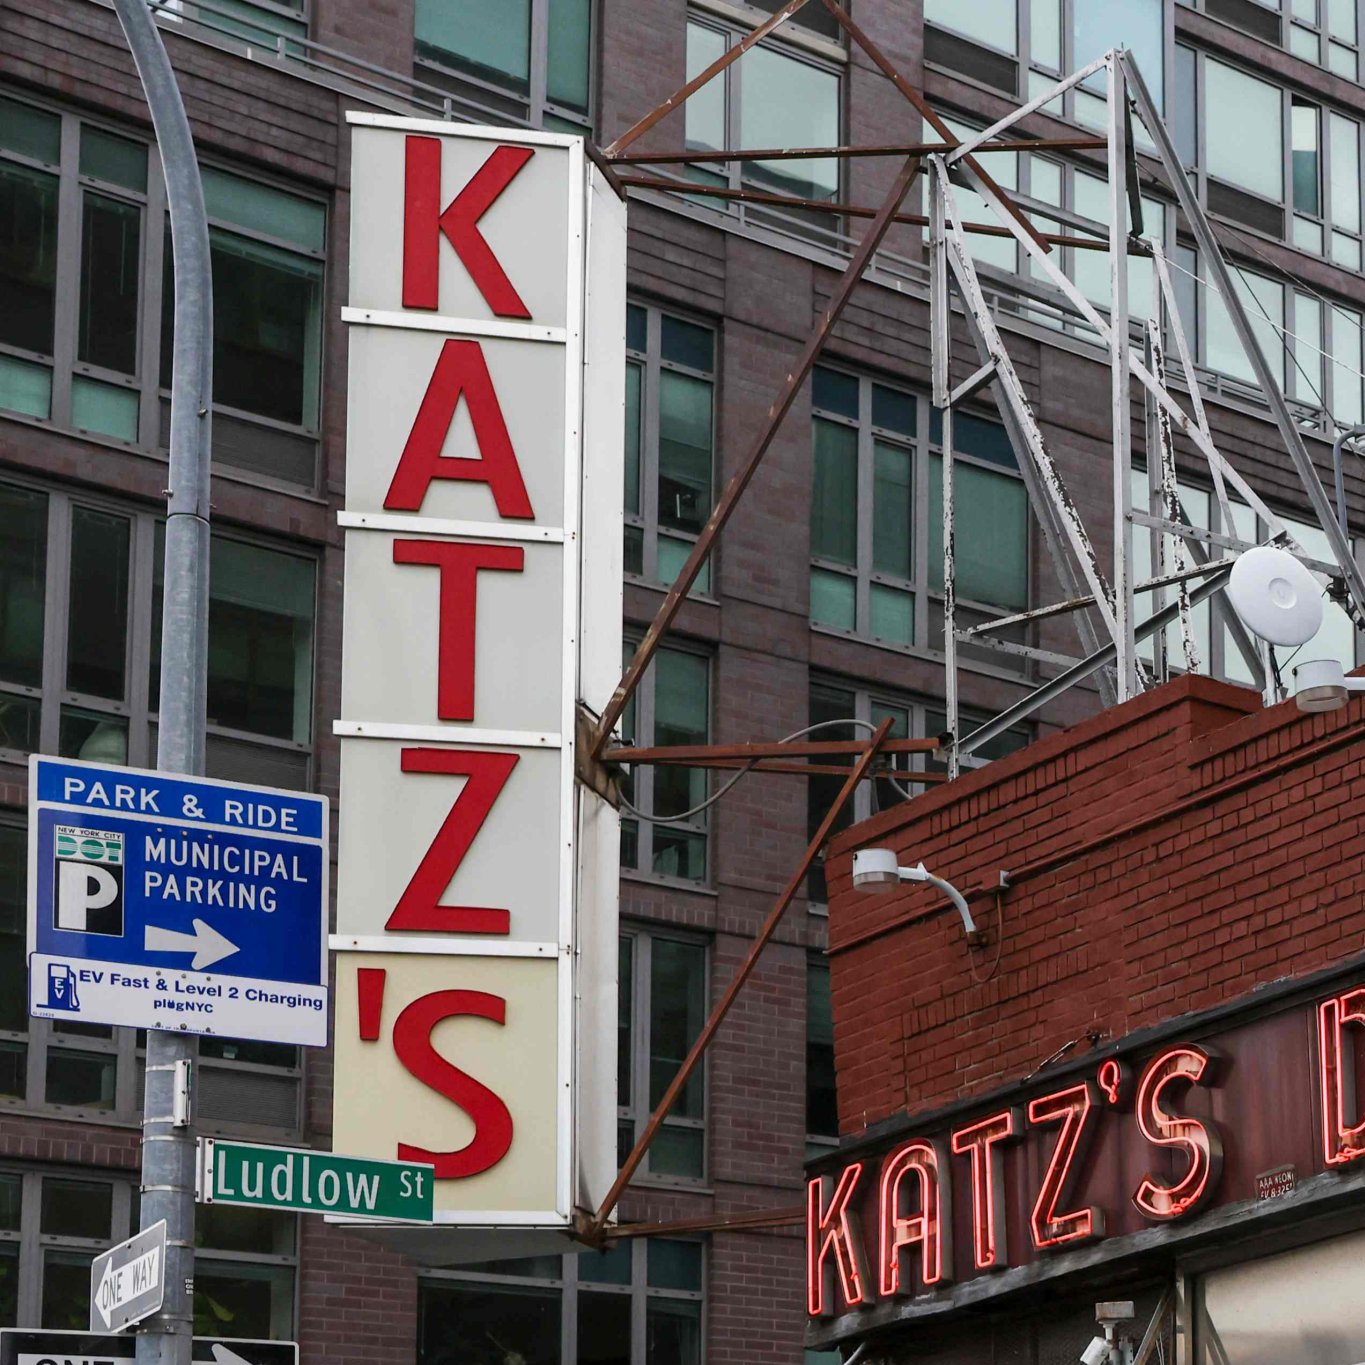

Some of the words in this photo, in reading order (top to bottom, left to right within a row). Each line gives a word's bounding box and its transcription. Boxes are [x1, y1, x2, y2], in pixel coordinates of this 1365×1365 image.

[357, 135, 535, 1179] KATZ'S
[64, 777, 160, 813] PARK
[182, 794, 205, 819] &
[225, 800, 298, 832] RIDE
[58, 826, 76, 835] NEW
[80, 828, 100, 838] YORK
[104, 831, 122, 840] CITY
[145, 835, 308, 883] MUNICIPAL
[144, 871, 277, 913] PARKING
[79, 969, 104, 984] EV
[110, 973, 149, 990] Fast
[155, 979, 168, 991] &
[175, 980, 222, 998] Level
[228, 987, 239, 999] 2
[245, 988, 324, 1012] Charging
[218, 1149, 381, 1211] Ludlow
[399, 1169, 425, 1200] St
[806, 1042, 1221, 1317] KATZ'S
[102, 1271, 123, 1311] ONE
[132, 1253, 156, 1295] WAY
